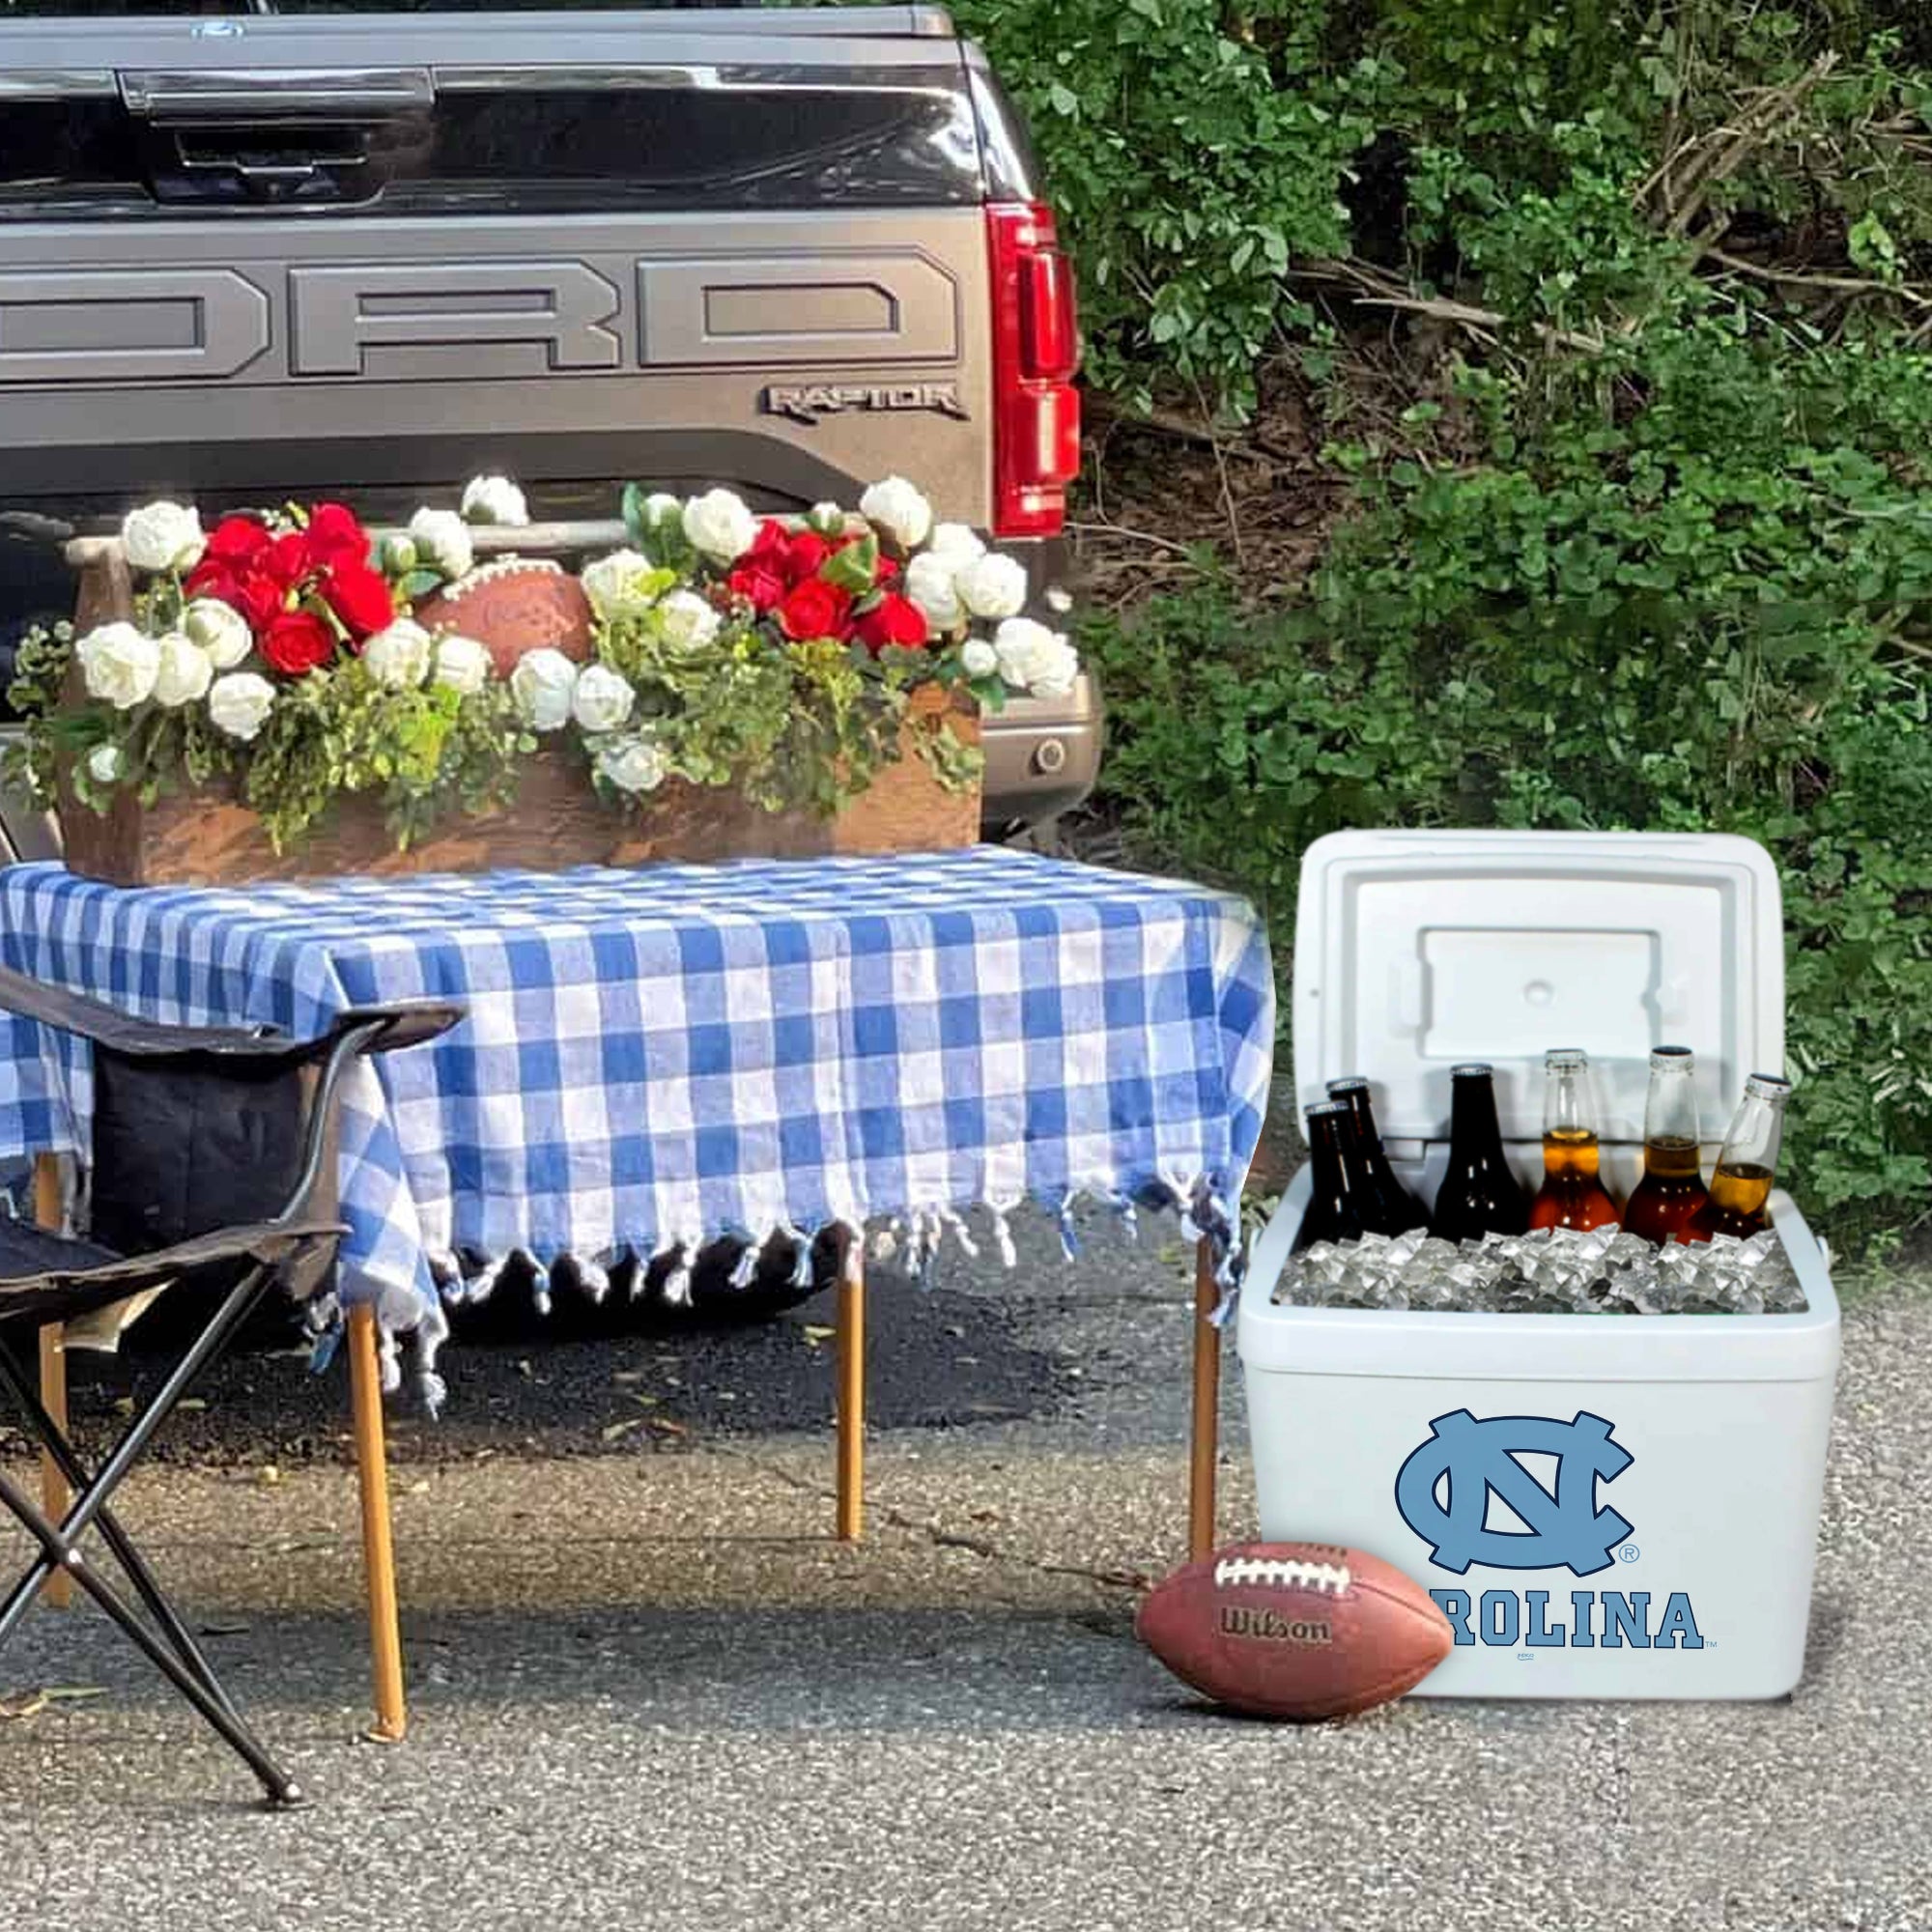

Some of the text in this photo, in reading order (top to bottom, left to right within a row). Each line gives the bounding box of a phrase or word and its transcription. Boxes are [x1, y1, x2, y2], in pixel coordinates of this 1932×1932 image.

[760, 384, 970, 425] RAPTOR
[1220, 1606, 1330, 1640] Wilson
[1429, 1589, 1704, 1649] ROLINA
